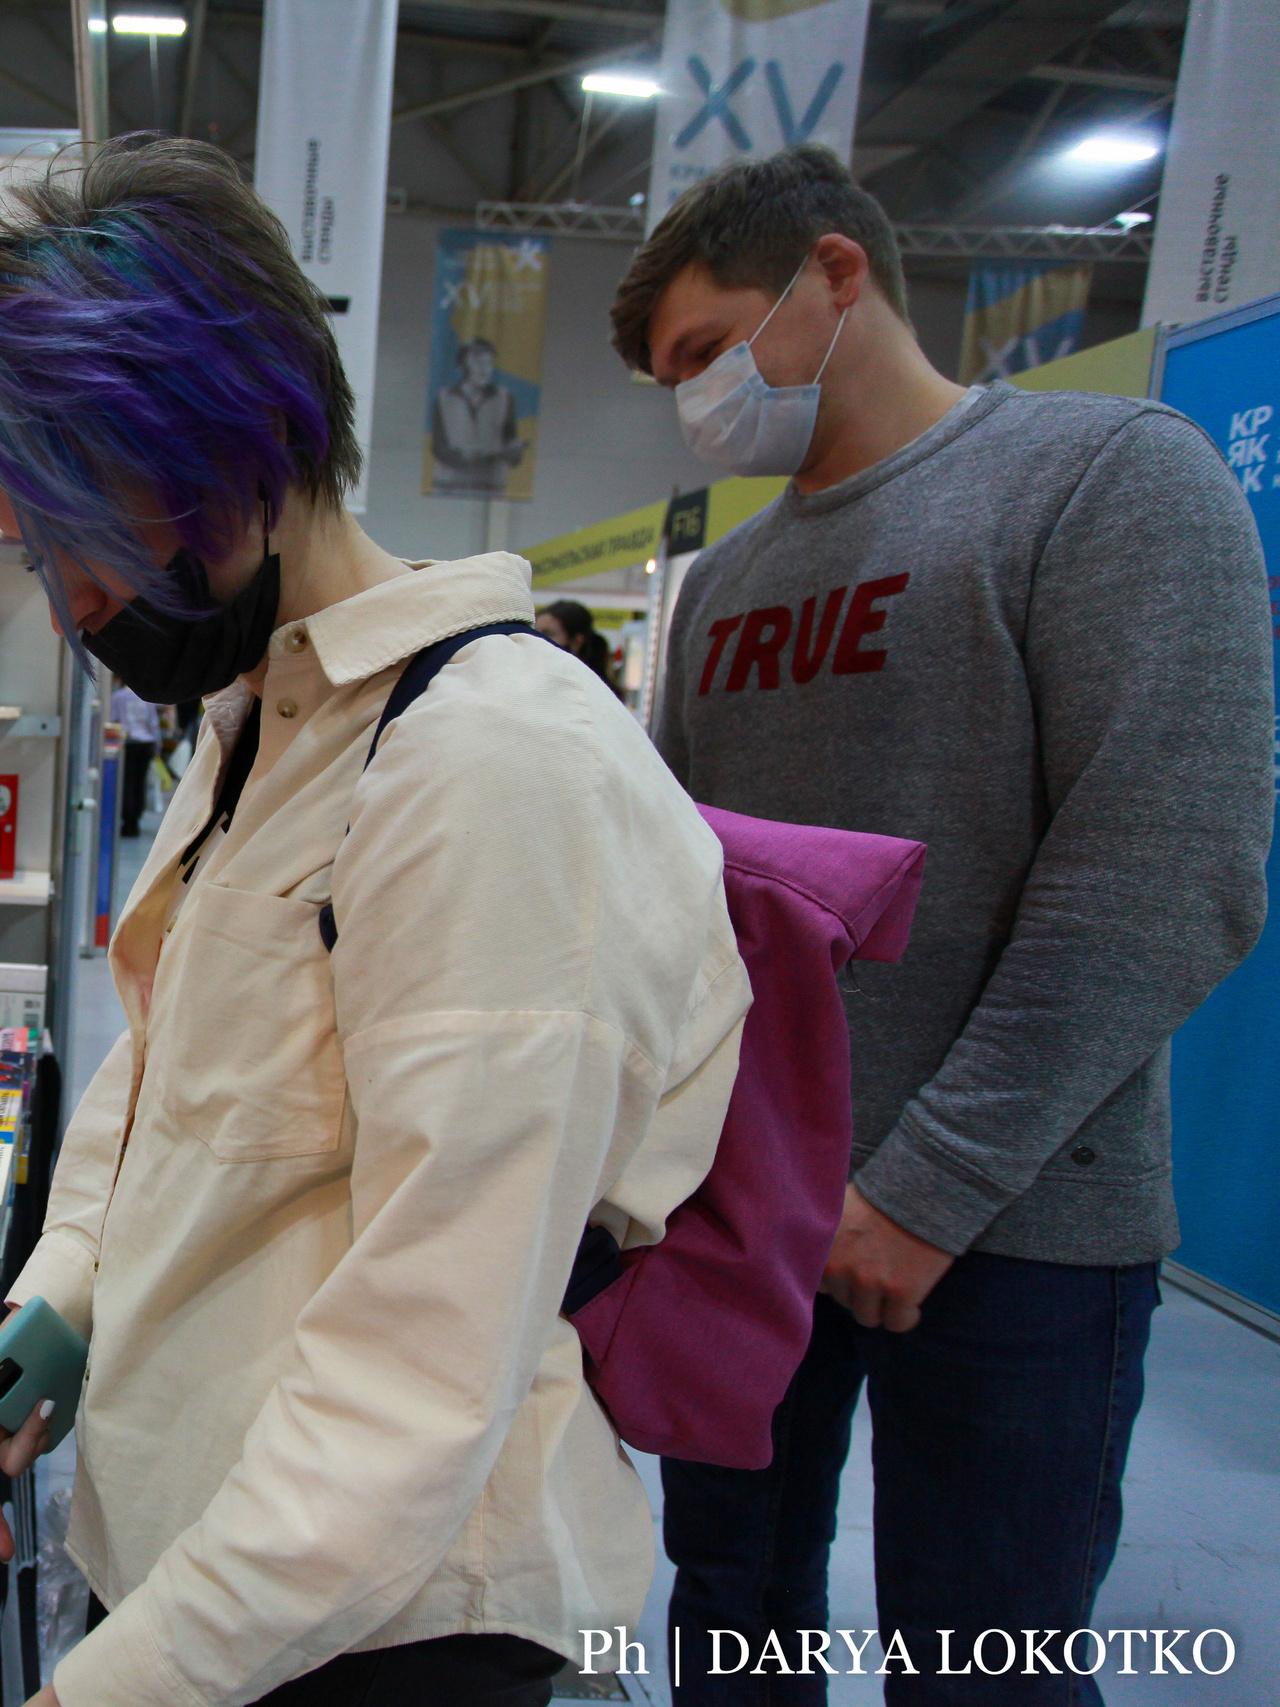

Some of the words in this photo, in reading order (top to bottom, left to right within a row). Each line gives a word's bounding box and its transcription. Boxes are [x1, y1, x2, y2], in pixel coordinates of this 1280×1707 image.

[675, 56, 844, 150] XV
[1196, 174, 1229, 302] выставочные
[1214, 236, 1238, 303] стенды
[1228, 405, 1273, 441] КР
[698, 571, 910, 697] TRUE
